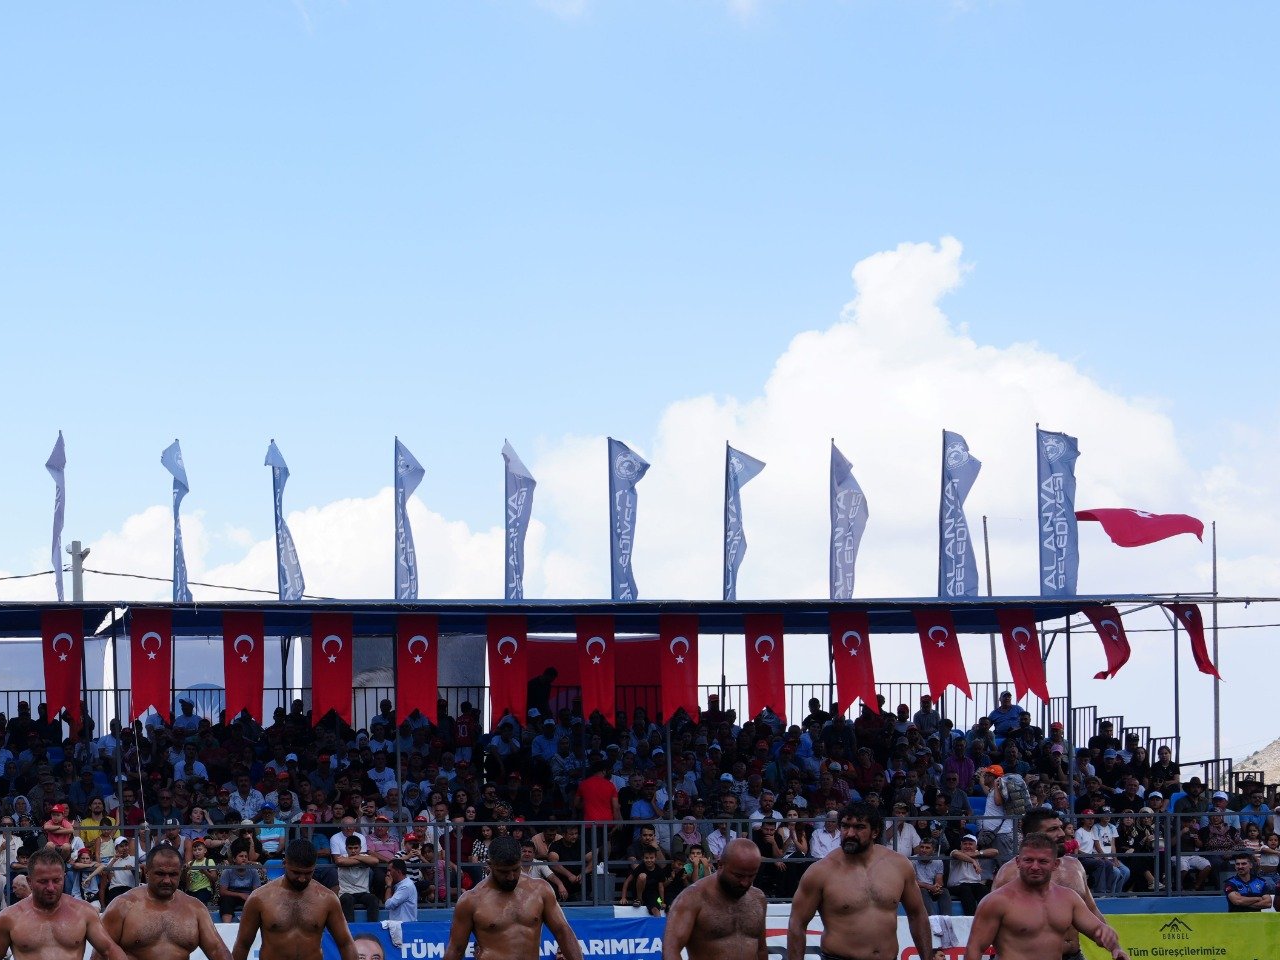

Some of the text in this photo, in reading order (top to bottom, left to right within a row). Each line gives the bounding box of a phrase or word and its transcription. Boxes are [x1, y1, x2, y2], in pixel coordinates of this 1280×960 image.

[944, 480, 956, 597] ALANYA
[1040, 475, 1057, 590] ALANYA
[401, 938, 445, 959] TÜM
[1128, 946, 1227, 958] Tüm Güreşçilerimize
